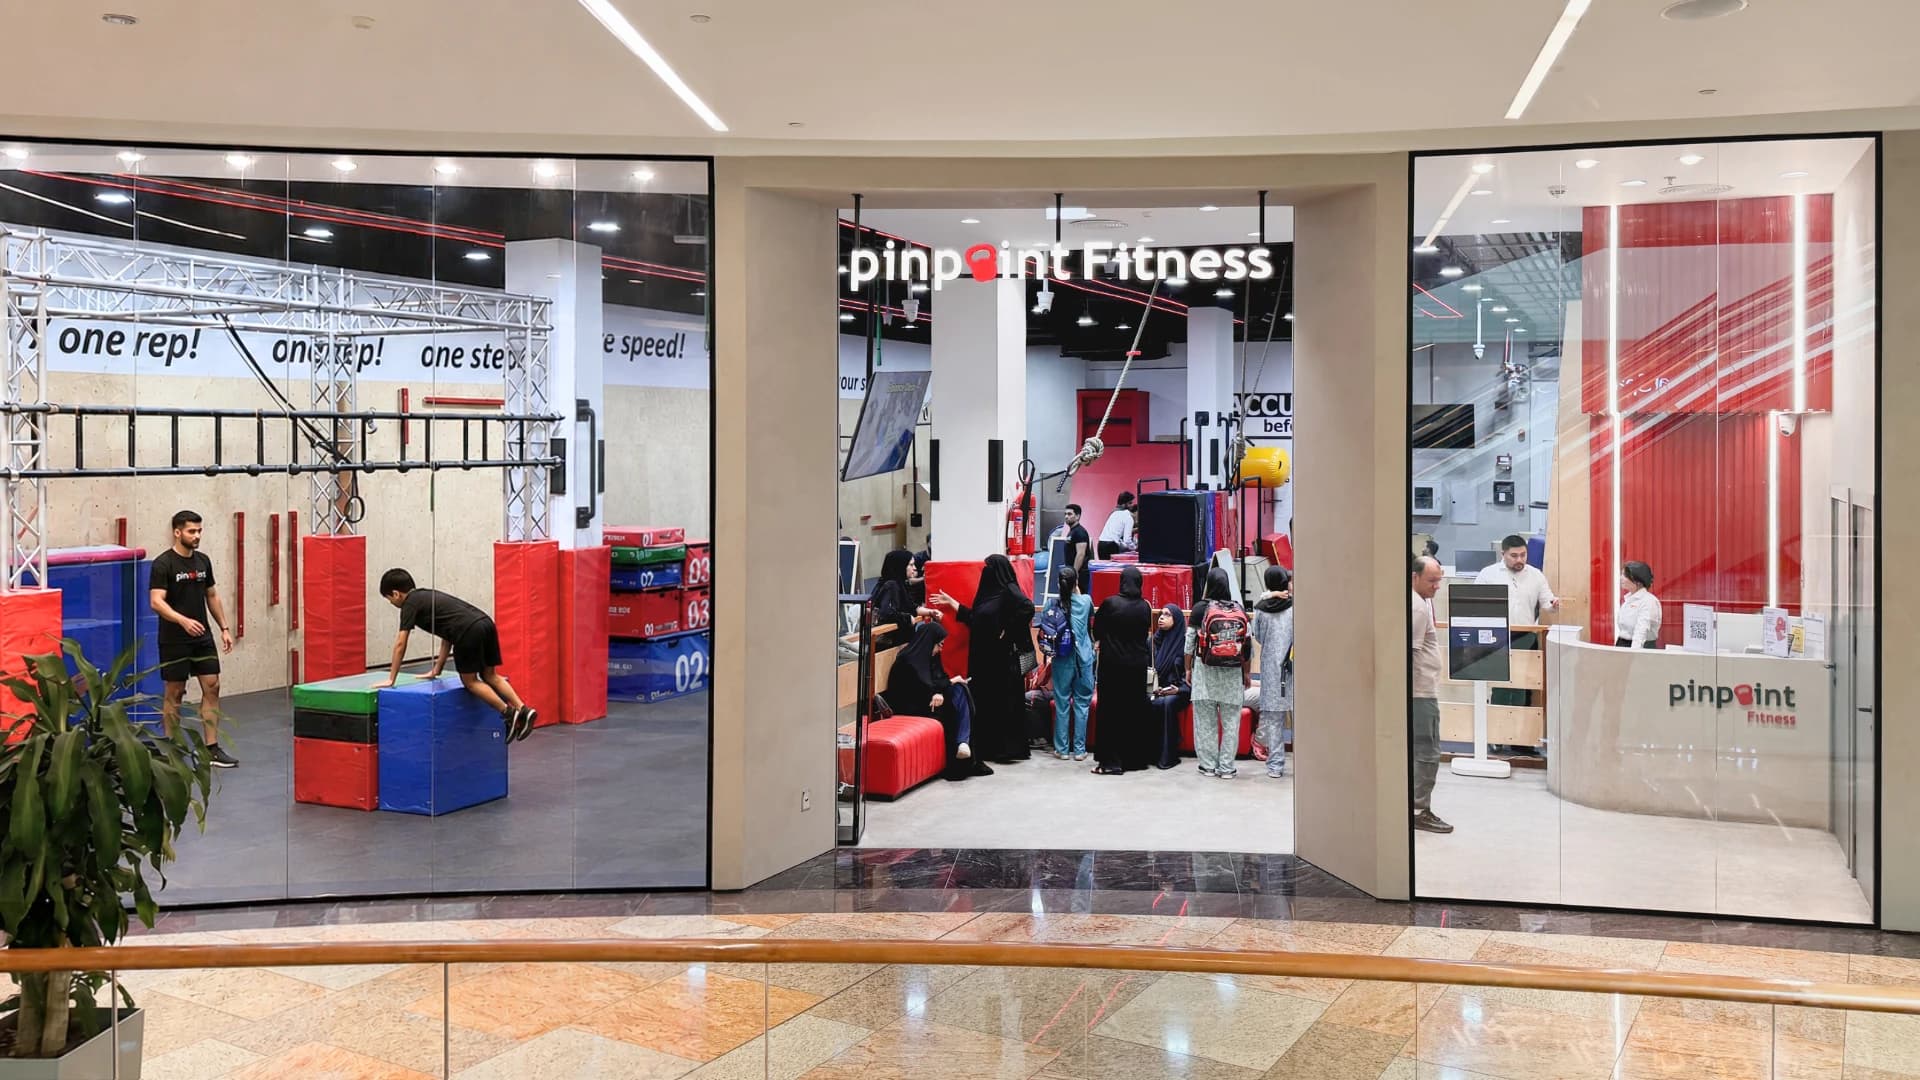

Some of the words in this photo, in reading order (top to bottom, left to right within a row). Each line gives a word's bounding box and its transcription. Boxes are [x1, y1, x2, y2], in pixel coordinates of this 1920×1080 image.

[850, 240, 1071, 292] pinpoint
[1083, 241, 1273, 281] Fitness
[59, 327, 126, 356] one
[133, 328, 202, 367] rep!
[421, 346, 464, 368] one
[621, 332, 686, 362] speed!
[840, 376, 859, 390] our
[688, 599, 710, 628] 03
[1669, 679, 1796, 709] pinpoint
[1747, 711, 1796, 726] Fitness
